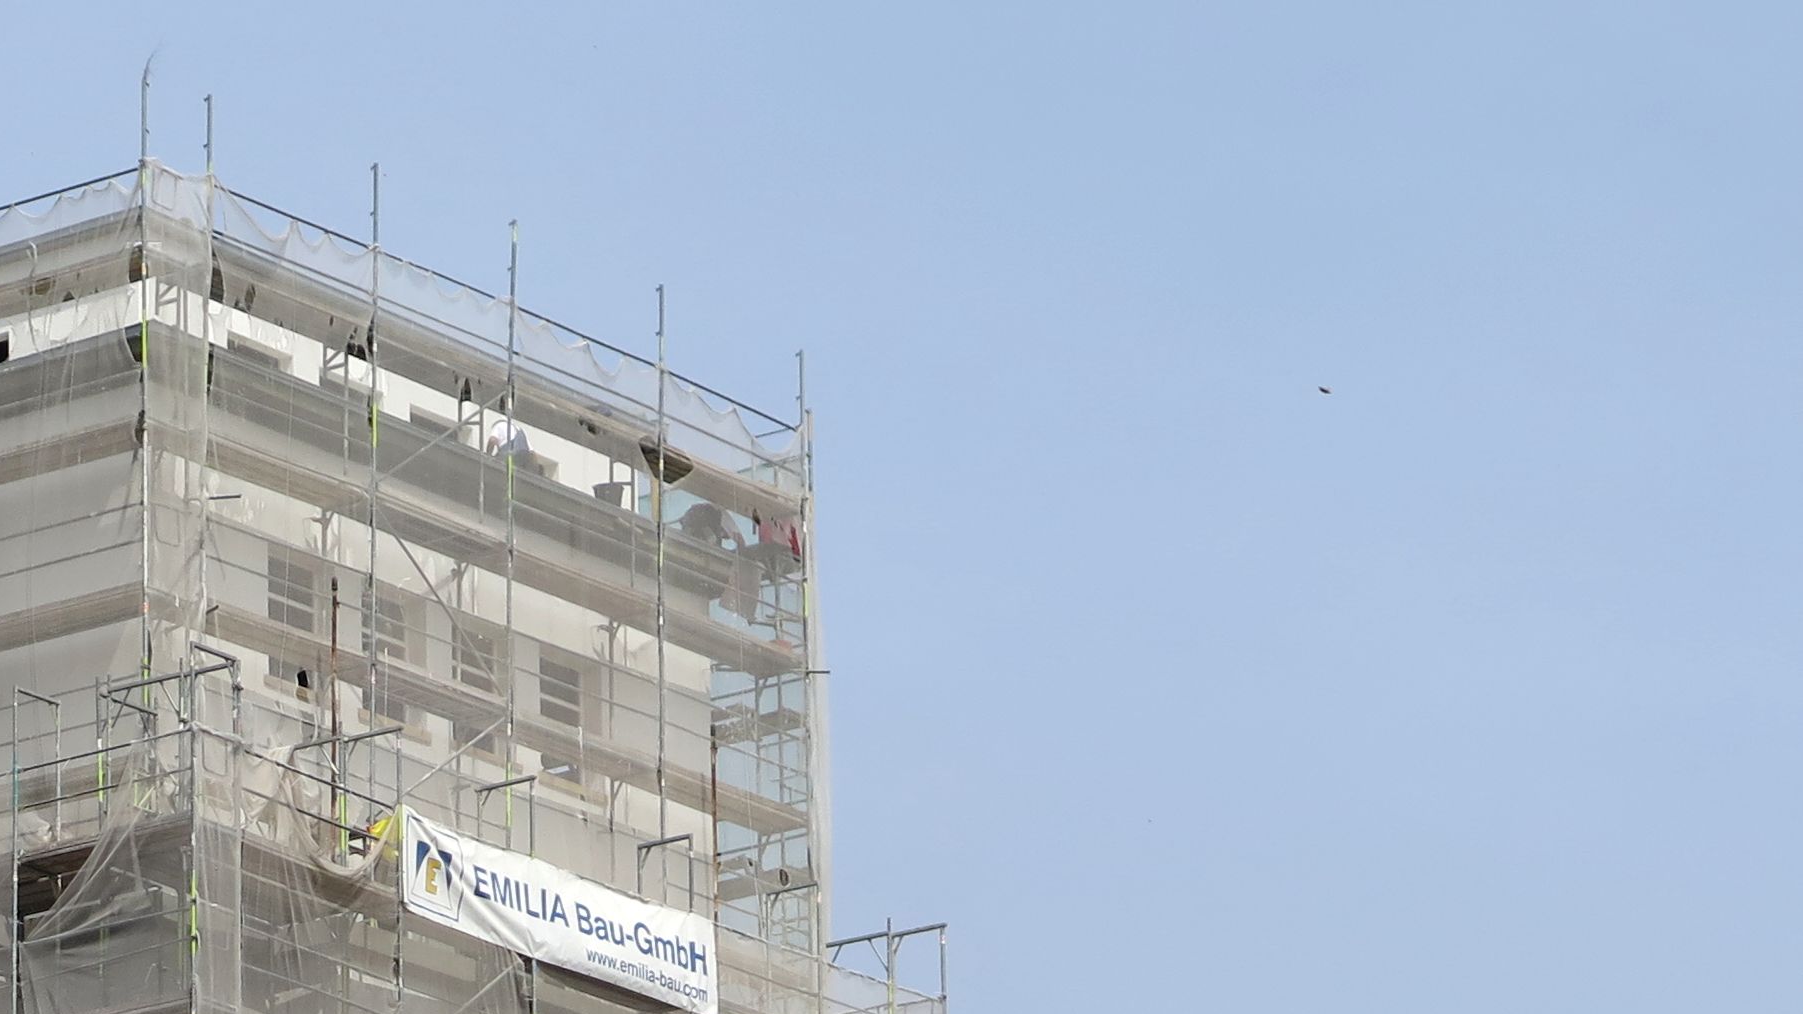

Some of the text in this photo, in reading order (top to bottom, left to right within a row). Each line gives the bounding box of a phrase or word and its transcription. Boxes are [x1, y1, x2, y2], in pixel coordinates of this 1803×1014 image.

[473, 864, 708, 976] EMILIA Bau-GmbH
[586, 948, 708, 1003] www.emilia-bau.com
